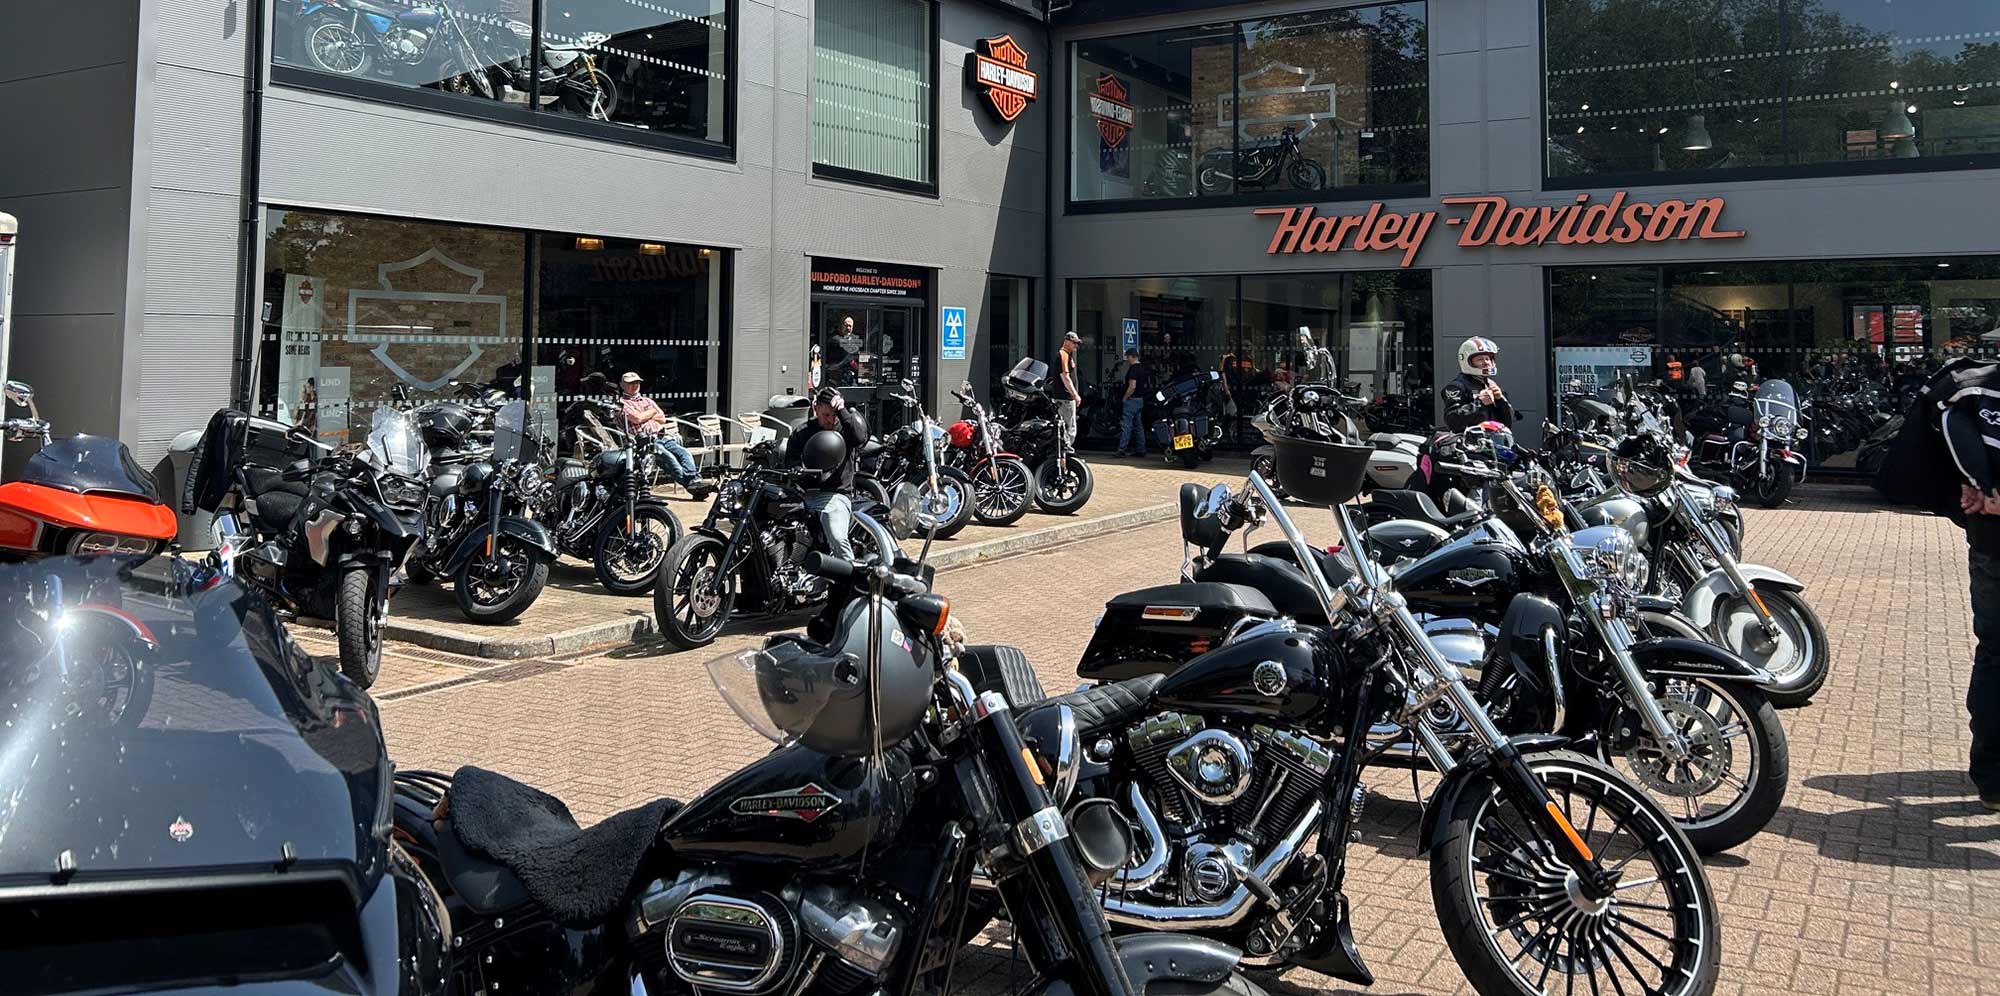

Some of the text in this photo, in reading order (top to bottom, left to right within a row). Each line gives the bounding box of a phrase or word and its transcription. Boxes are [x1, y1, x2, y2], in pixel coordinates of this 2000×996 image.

[994, 43, 1023, 67] MOTOR
[980, 60, 1035, 94] HARLEY-DAVIDSON
[993, 88, 1024, 116] CYCLES
[810, 271, 851, 283] UILDFORD
[1559, 365, 1573, 374] OUR
[320, 377, 341, 387] LIND
[741, 797, 826, 810] HARLEY-DAVIDSON
